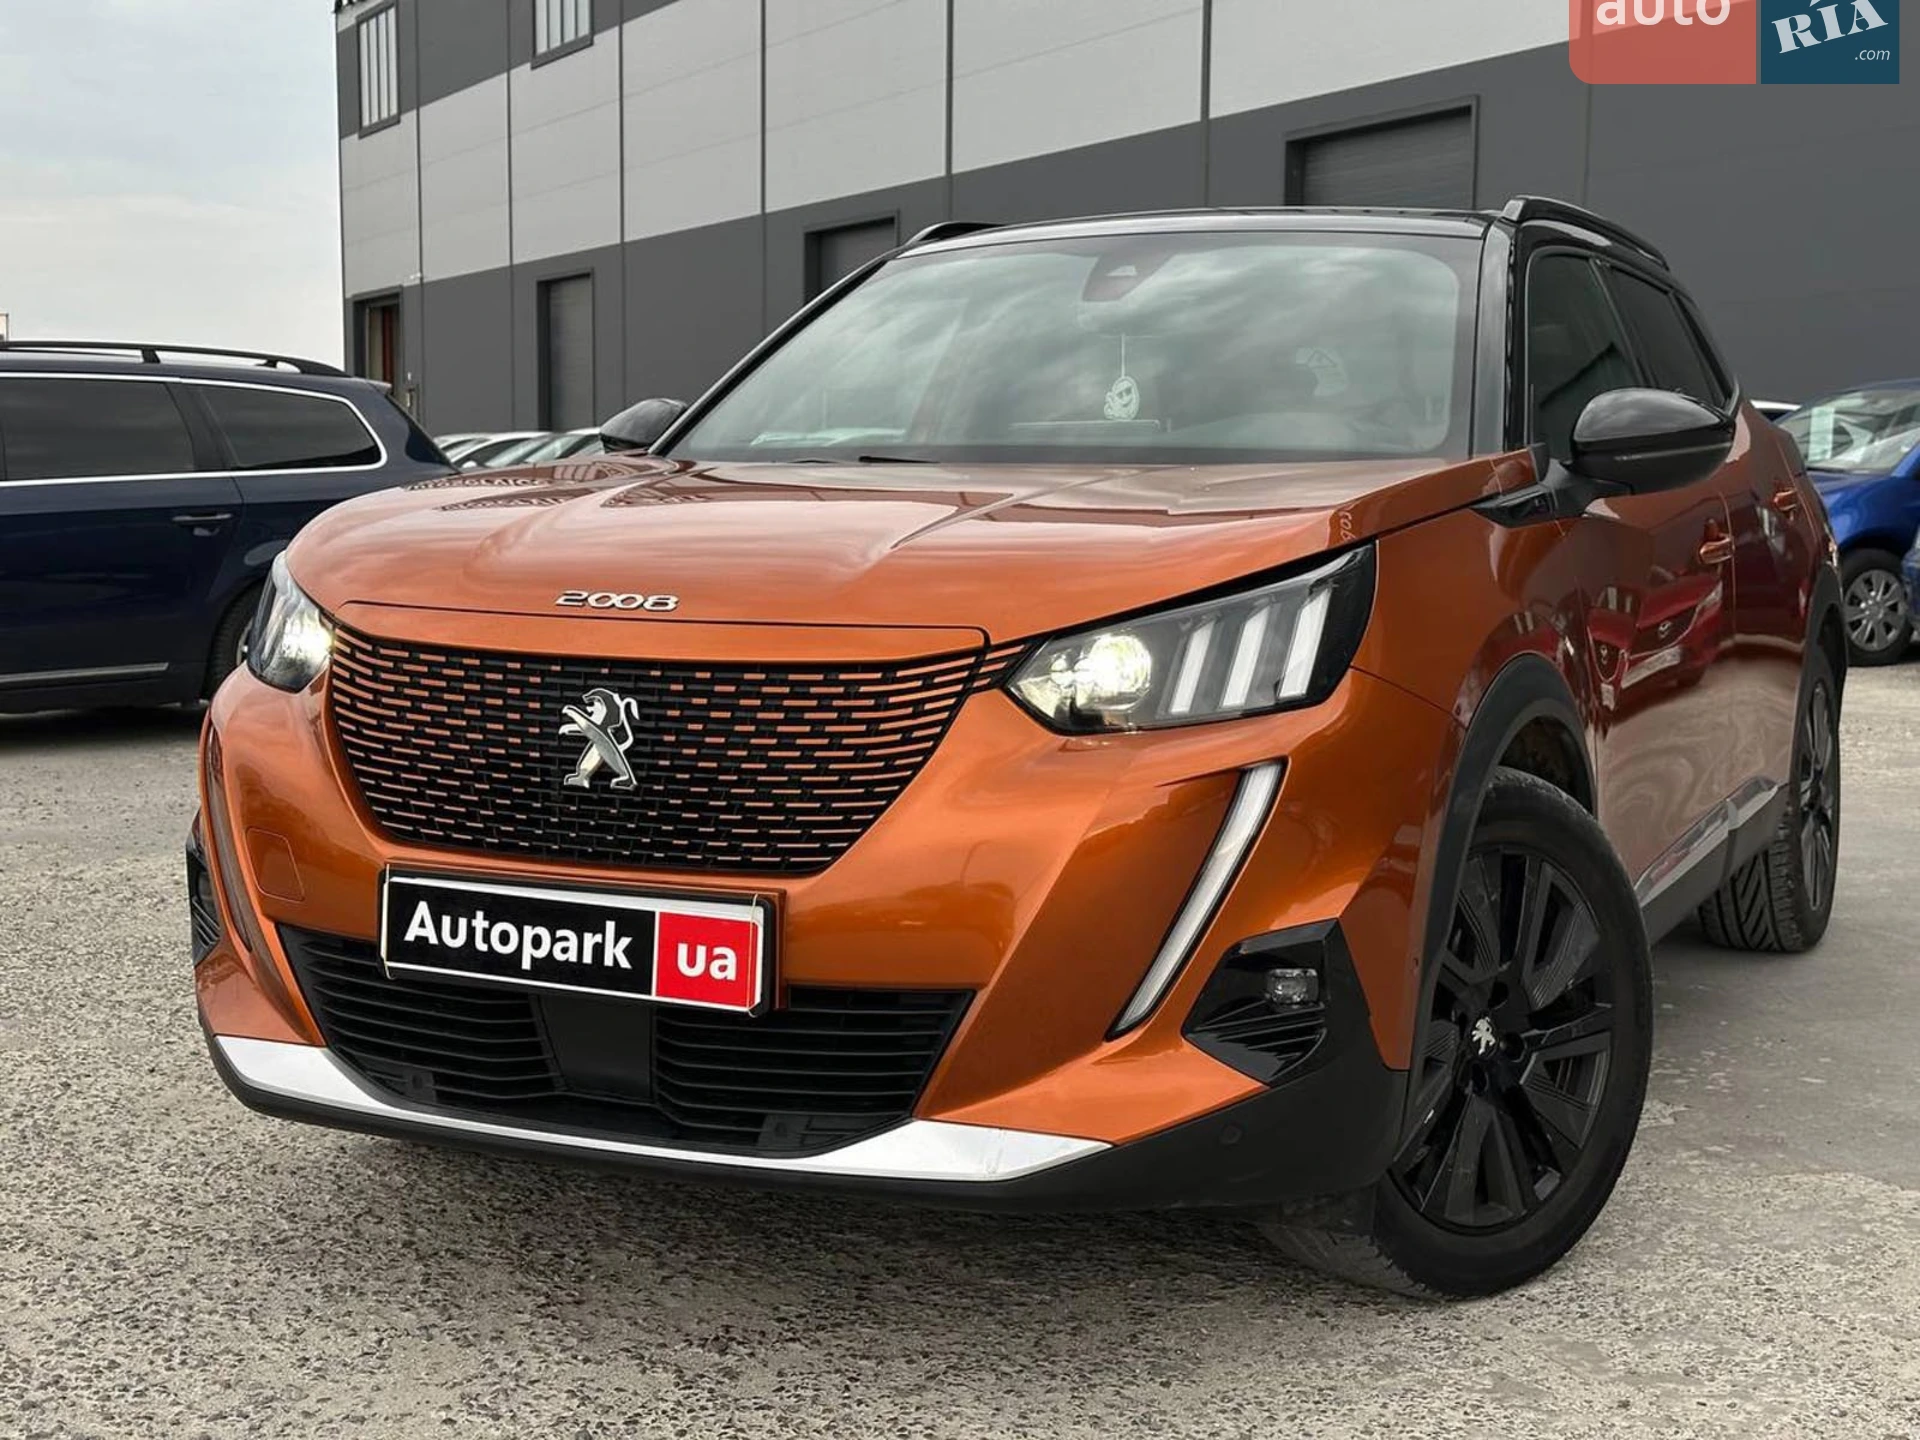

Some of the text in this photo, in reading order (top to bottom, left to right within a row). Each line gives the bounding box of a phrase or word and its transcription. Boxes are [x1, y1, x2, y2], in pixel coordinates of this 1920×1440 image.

[554, 590, 680, 612] 2008
[404, 901, 738, 982] Autopark ua
